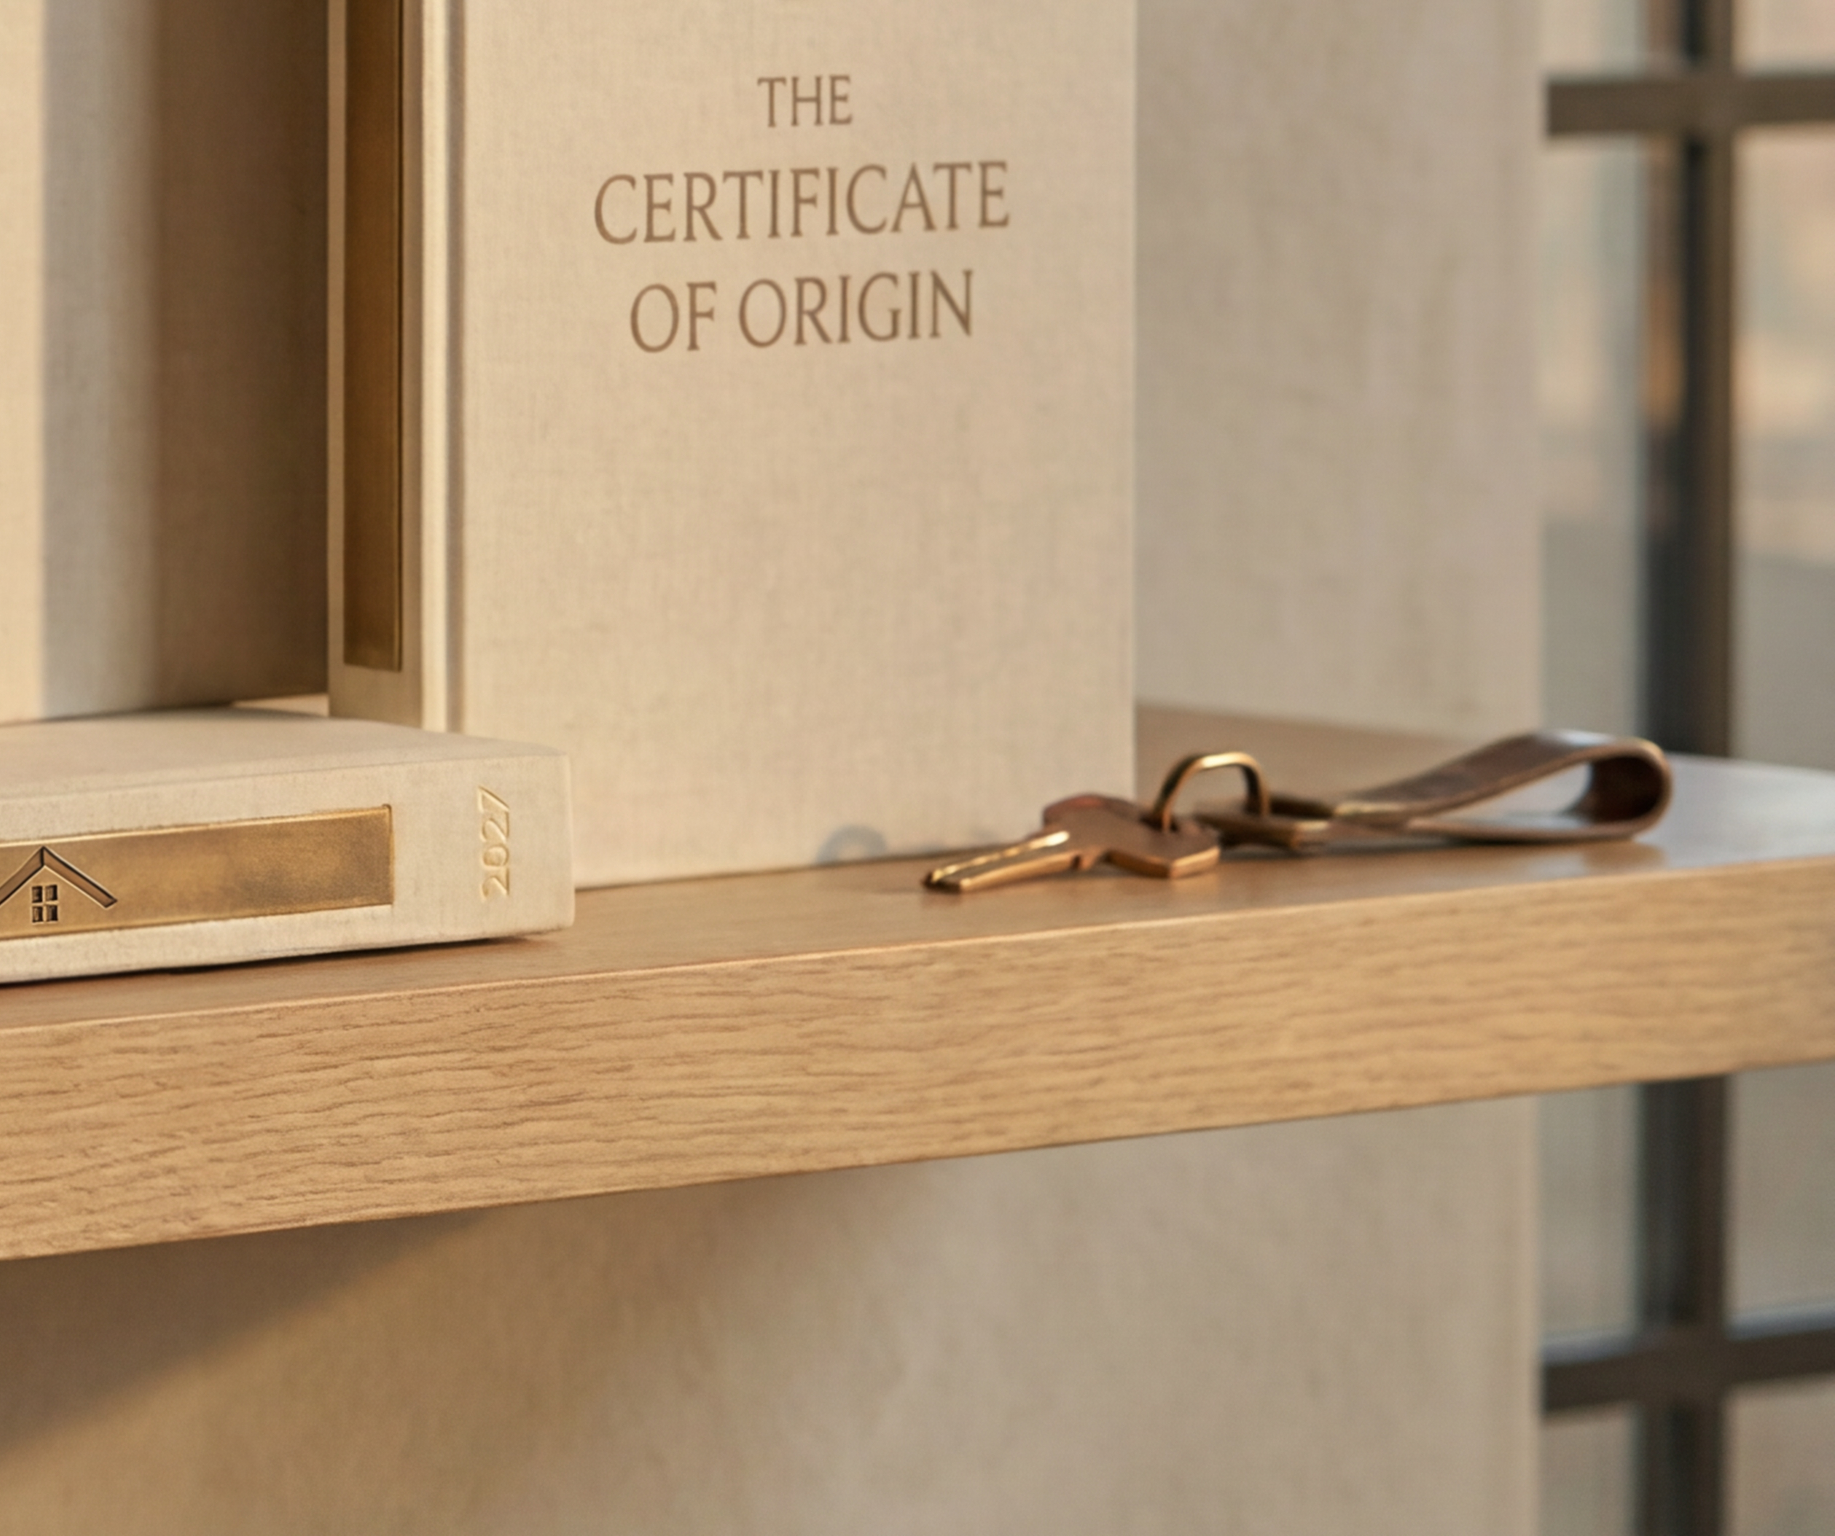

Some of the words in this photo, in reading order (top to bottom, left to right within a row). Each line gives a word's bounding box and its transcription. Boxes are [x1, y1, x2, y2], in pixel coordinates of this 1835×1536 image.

[758, 75, 853, 127] THE
[593, 160, 1010, 245] CERTIFICATE
[630, 282, 716, 353] OF
[737, 269, 974, 348] ORIGIN
[477, 785, 510, 902] 2027
